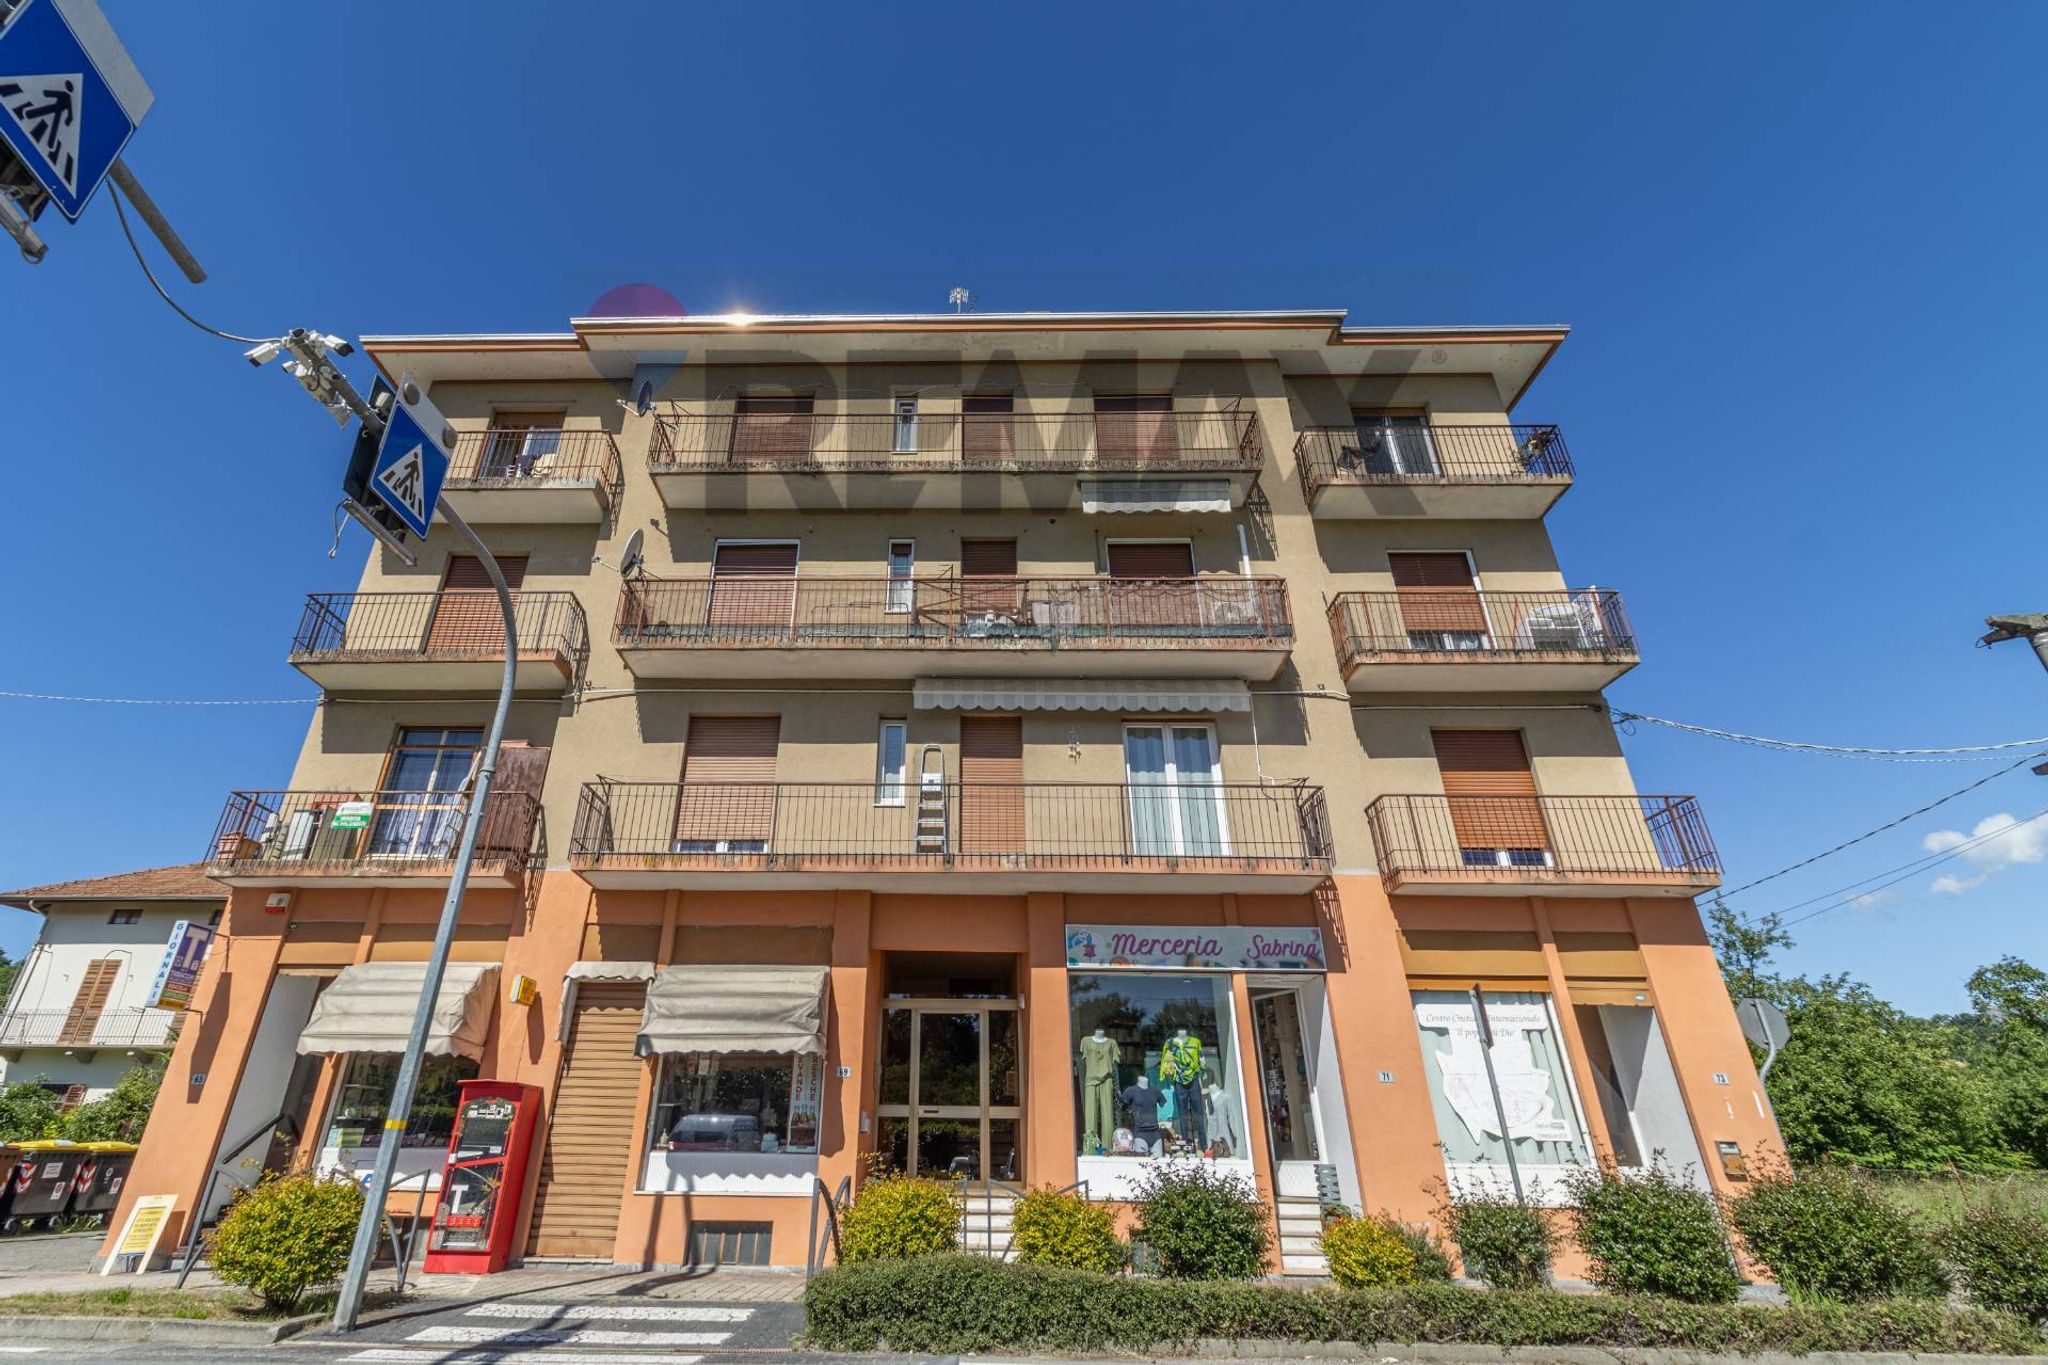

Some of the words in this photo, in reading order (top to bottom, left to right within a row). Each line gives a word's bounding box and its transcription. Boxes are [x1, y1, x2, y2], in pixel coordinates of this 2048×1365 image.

[152, 923, 185, 998] GIORNALI
[182, 926, 210, 969] T
[1111, 933, 1223, 956] Merceria
[1246, 934, 1320, 959] Sabrina
